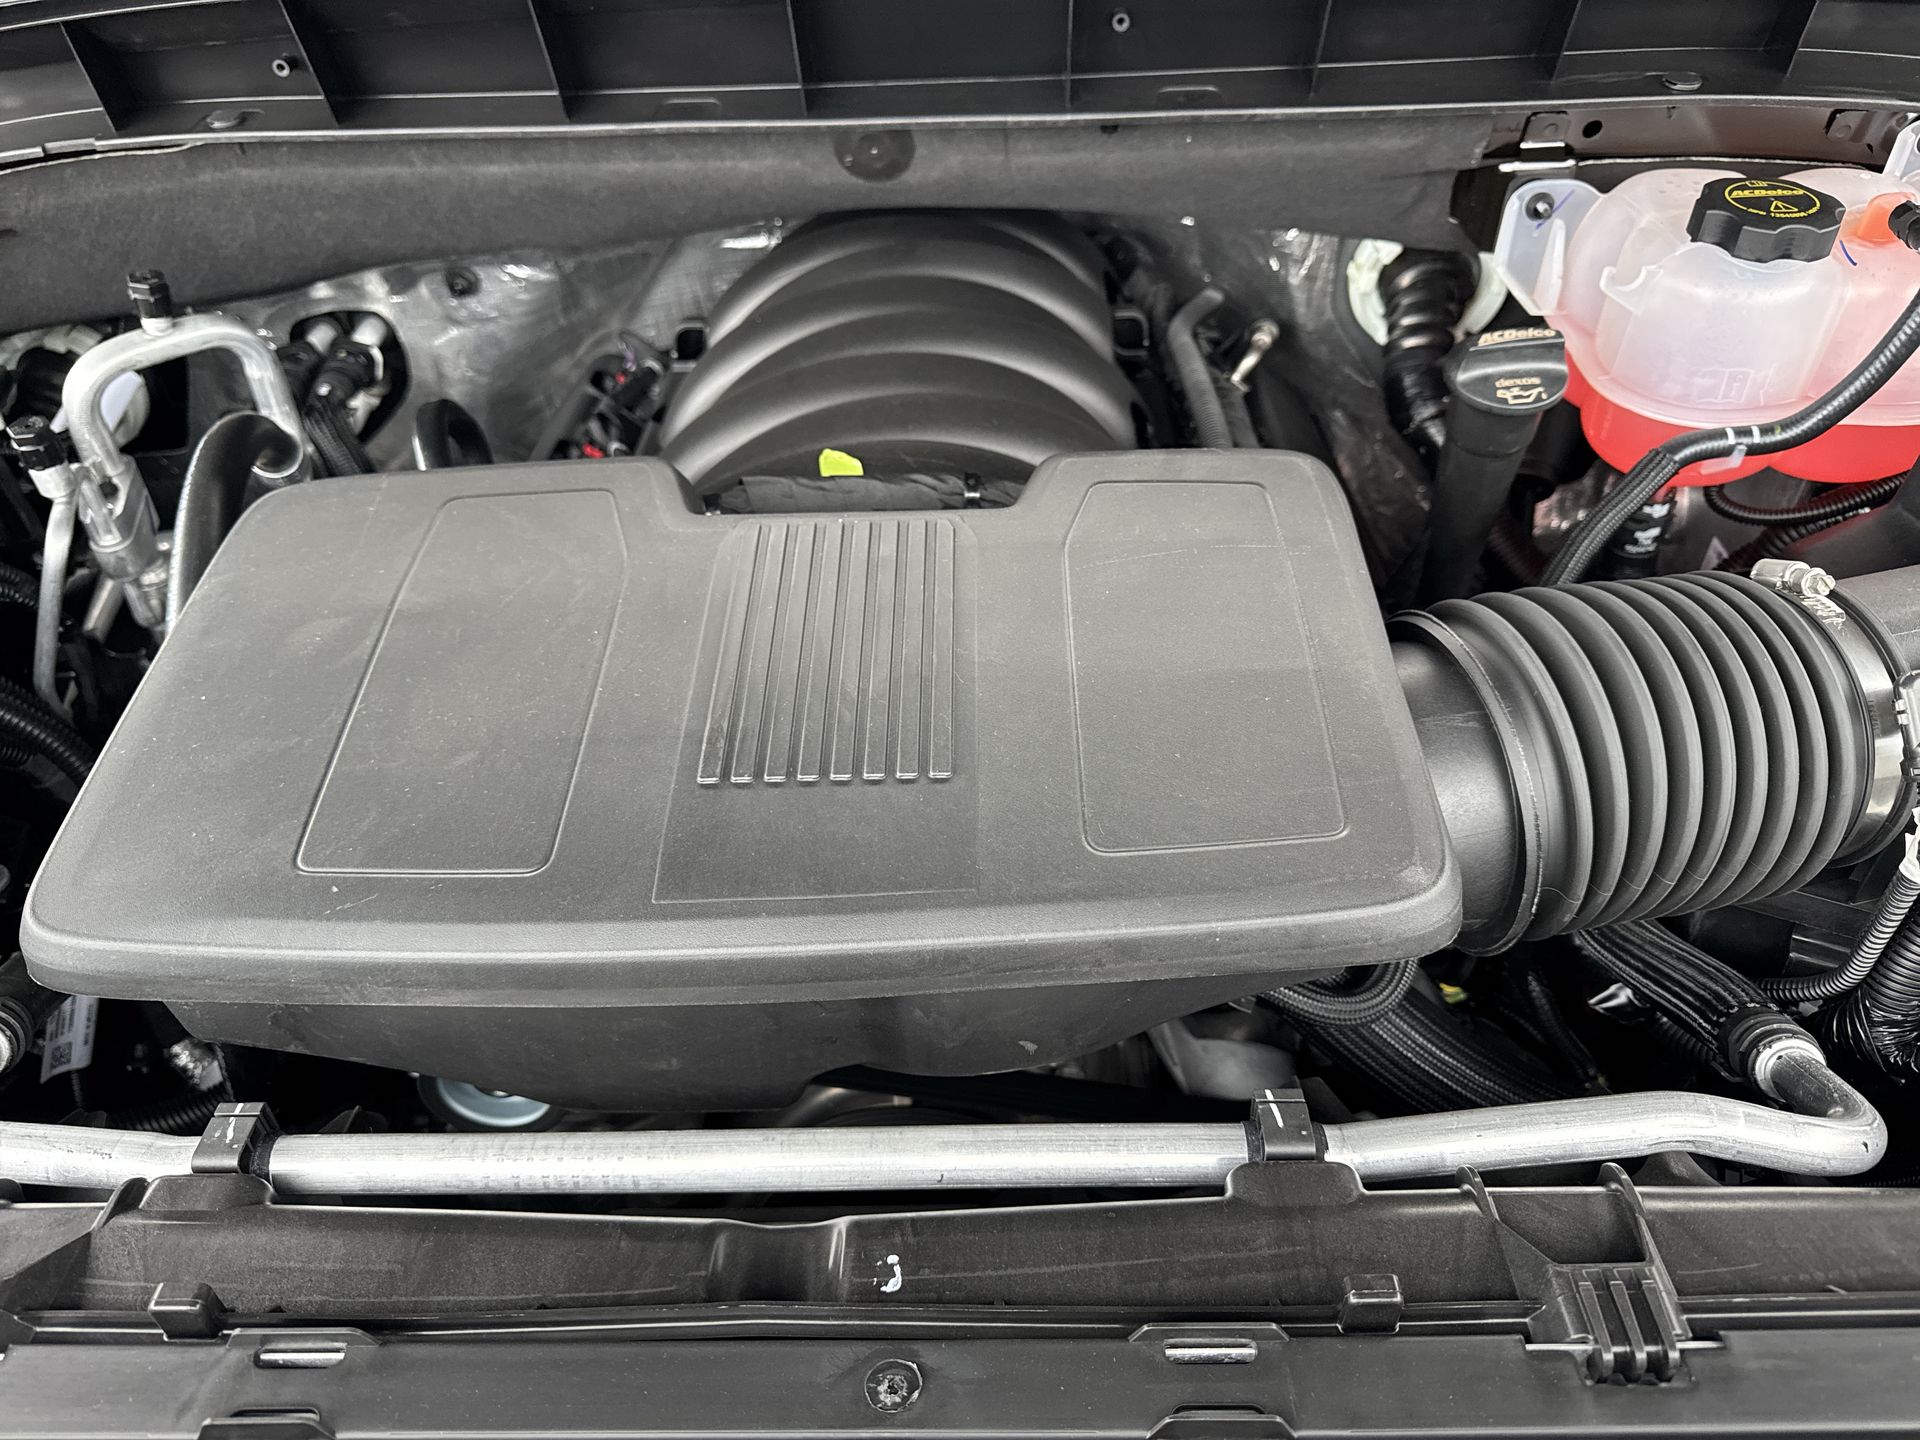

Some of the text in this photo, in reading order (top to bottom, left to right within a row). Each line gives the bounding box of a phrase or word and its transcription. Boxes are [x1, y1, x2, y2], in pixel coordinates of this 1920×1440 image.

[1730, 189, 1804, 197] ACDelco
[1478, 328, 1556, 346] ACDelco
[1495, 377, 1541, 388] dexos
